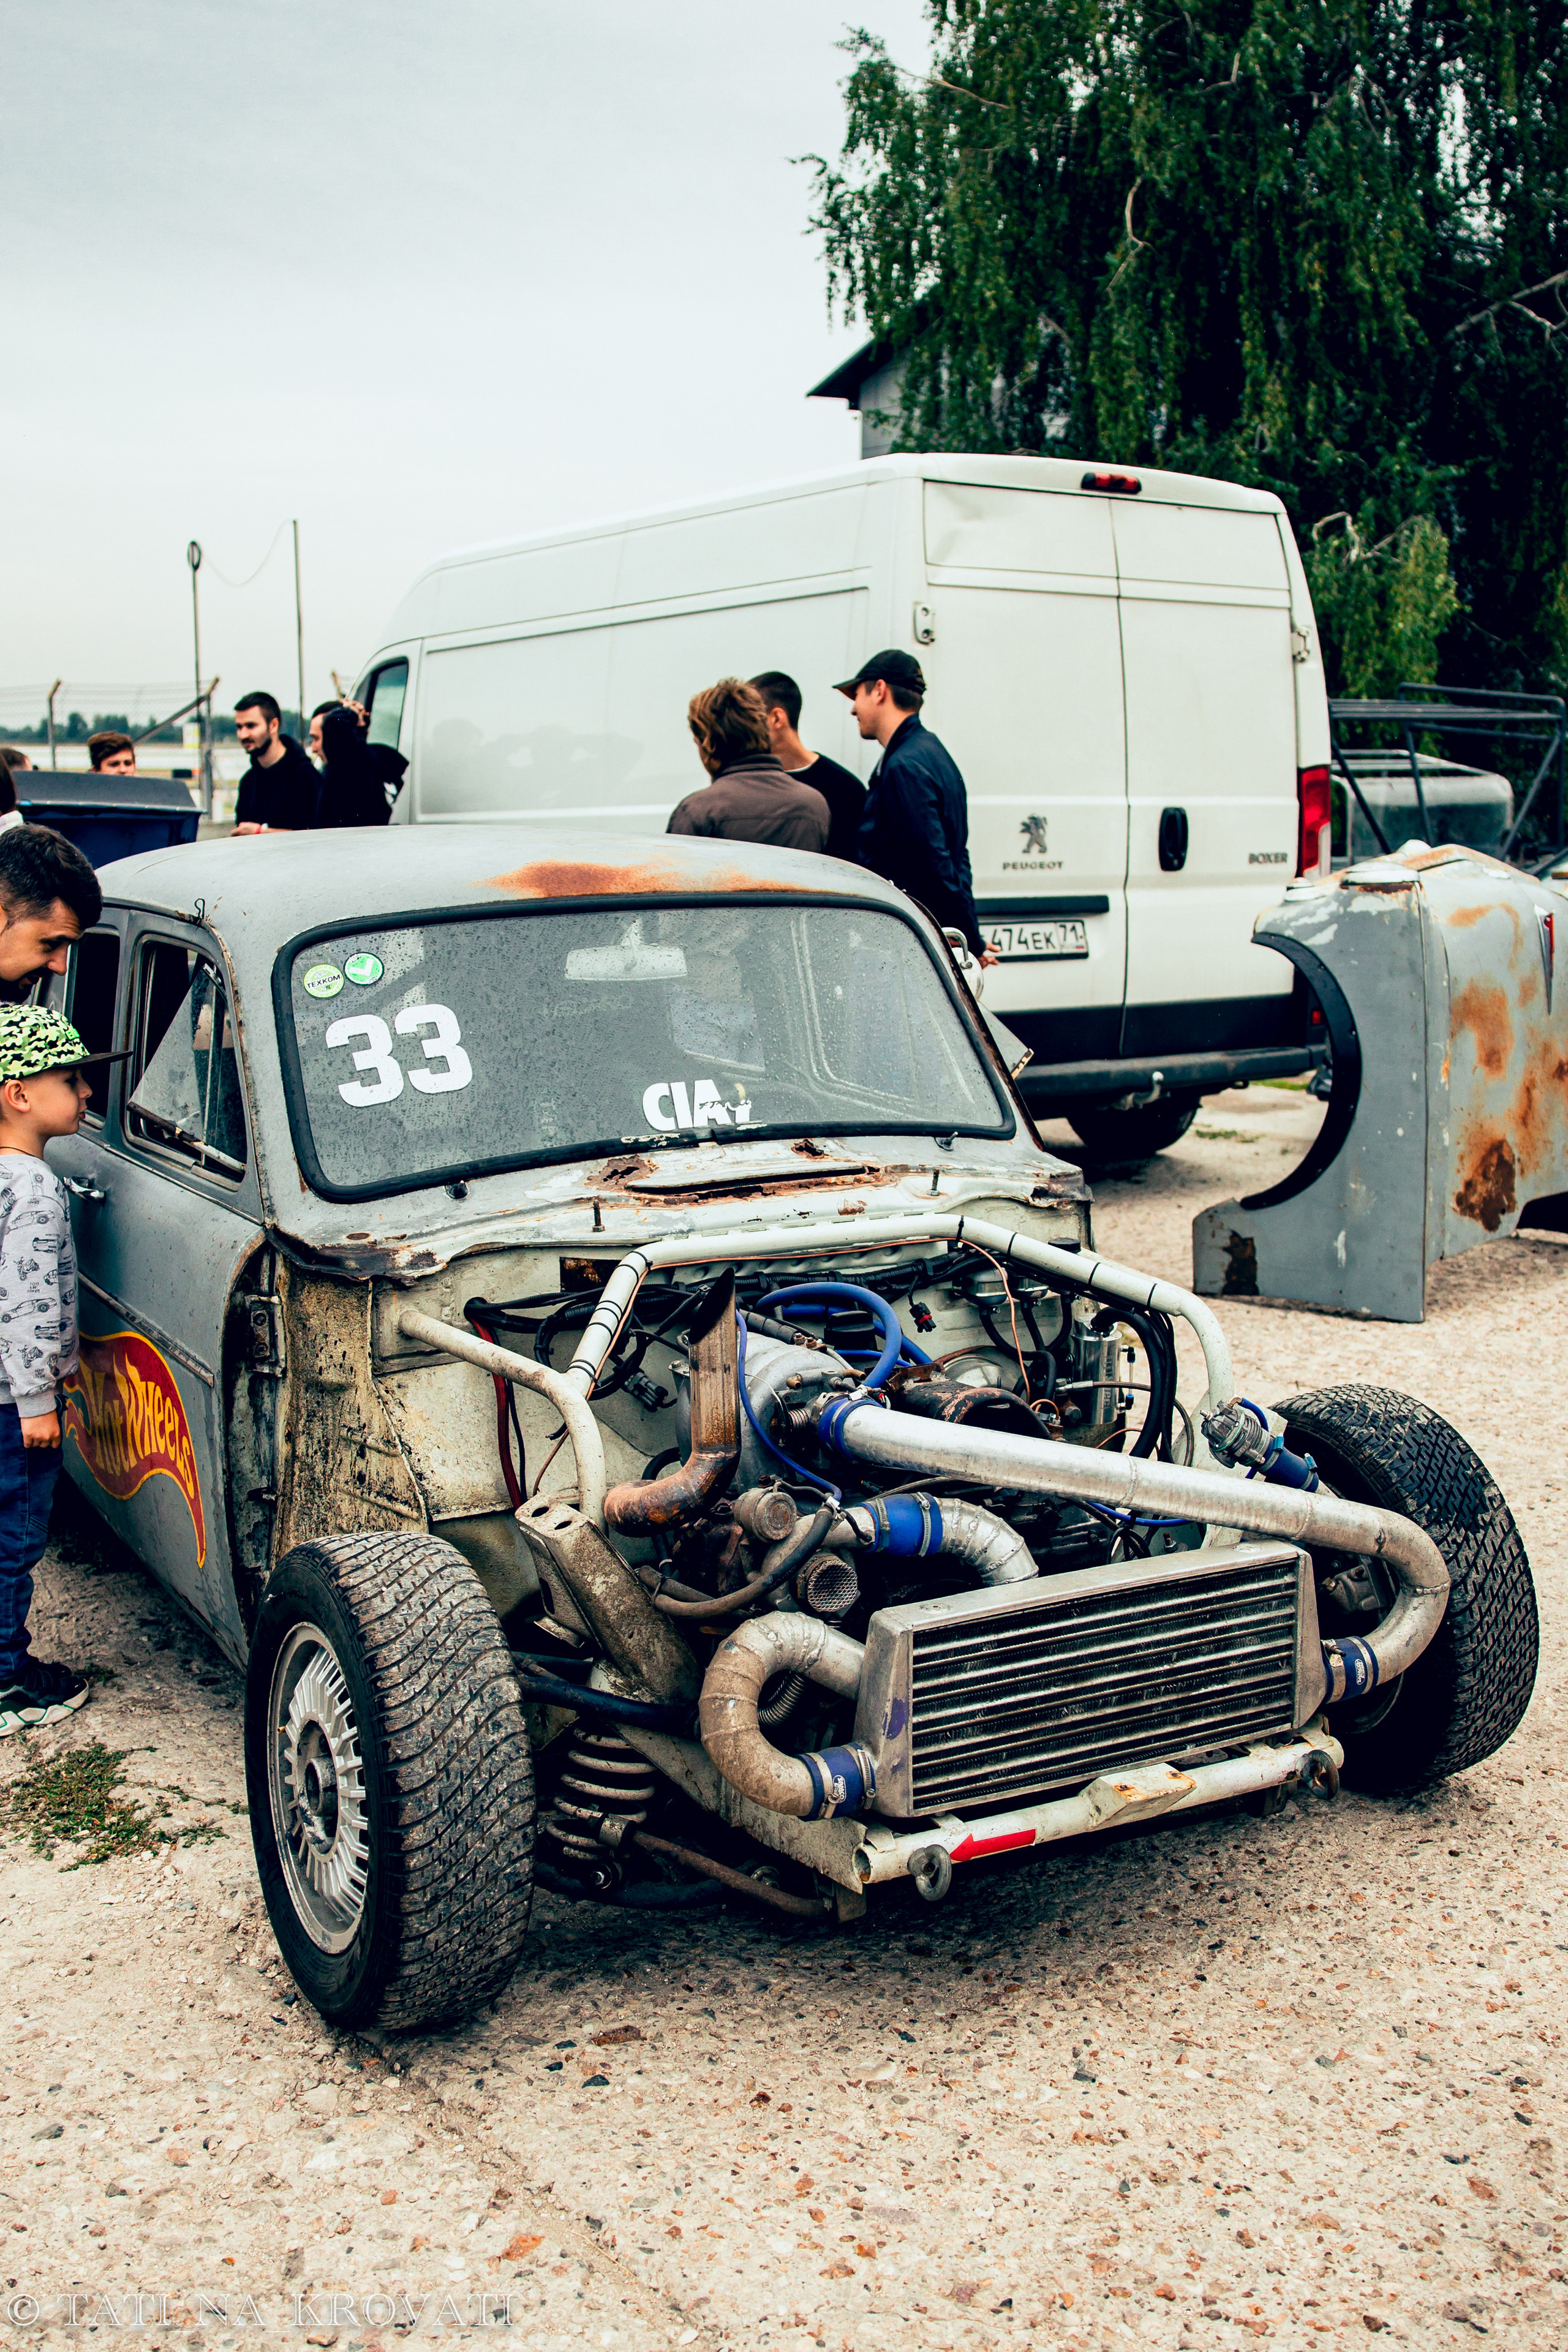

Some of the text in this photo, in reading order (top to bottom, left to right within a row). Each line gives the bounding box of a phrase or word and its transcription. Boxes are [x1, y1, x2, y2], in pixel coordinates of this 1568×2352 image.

[1003, 861, 1063, 870] PEUGEOT
[1249, 852, 1288, 864] BOXER
[981, 924, 1080, 951] 474EK 71
[325, 1003, 473, 1107] 33
